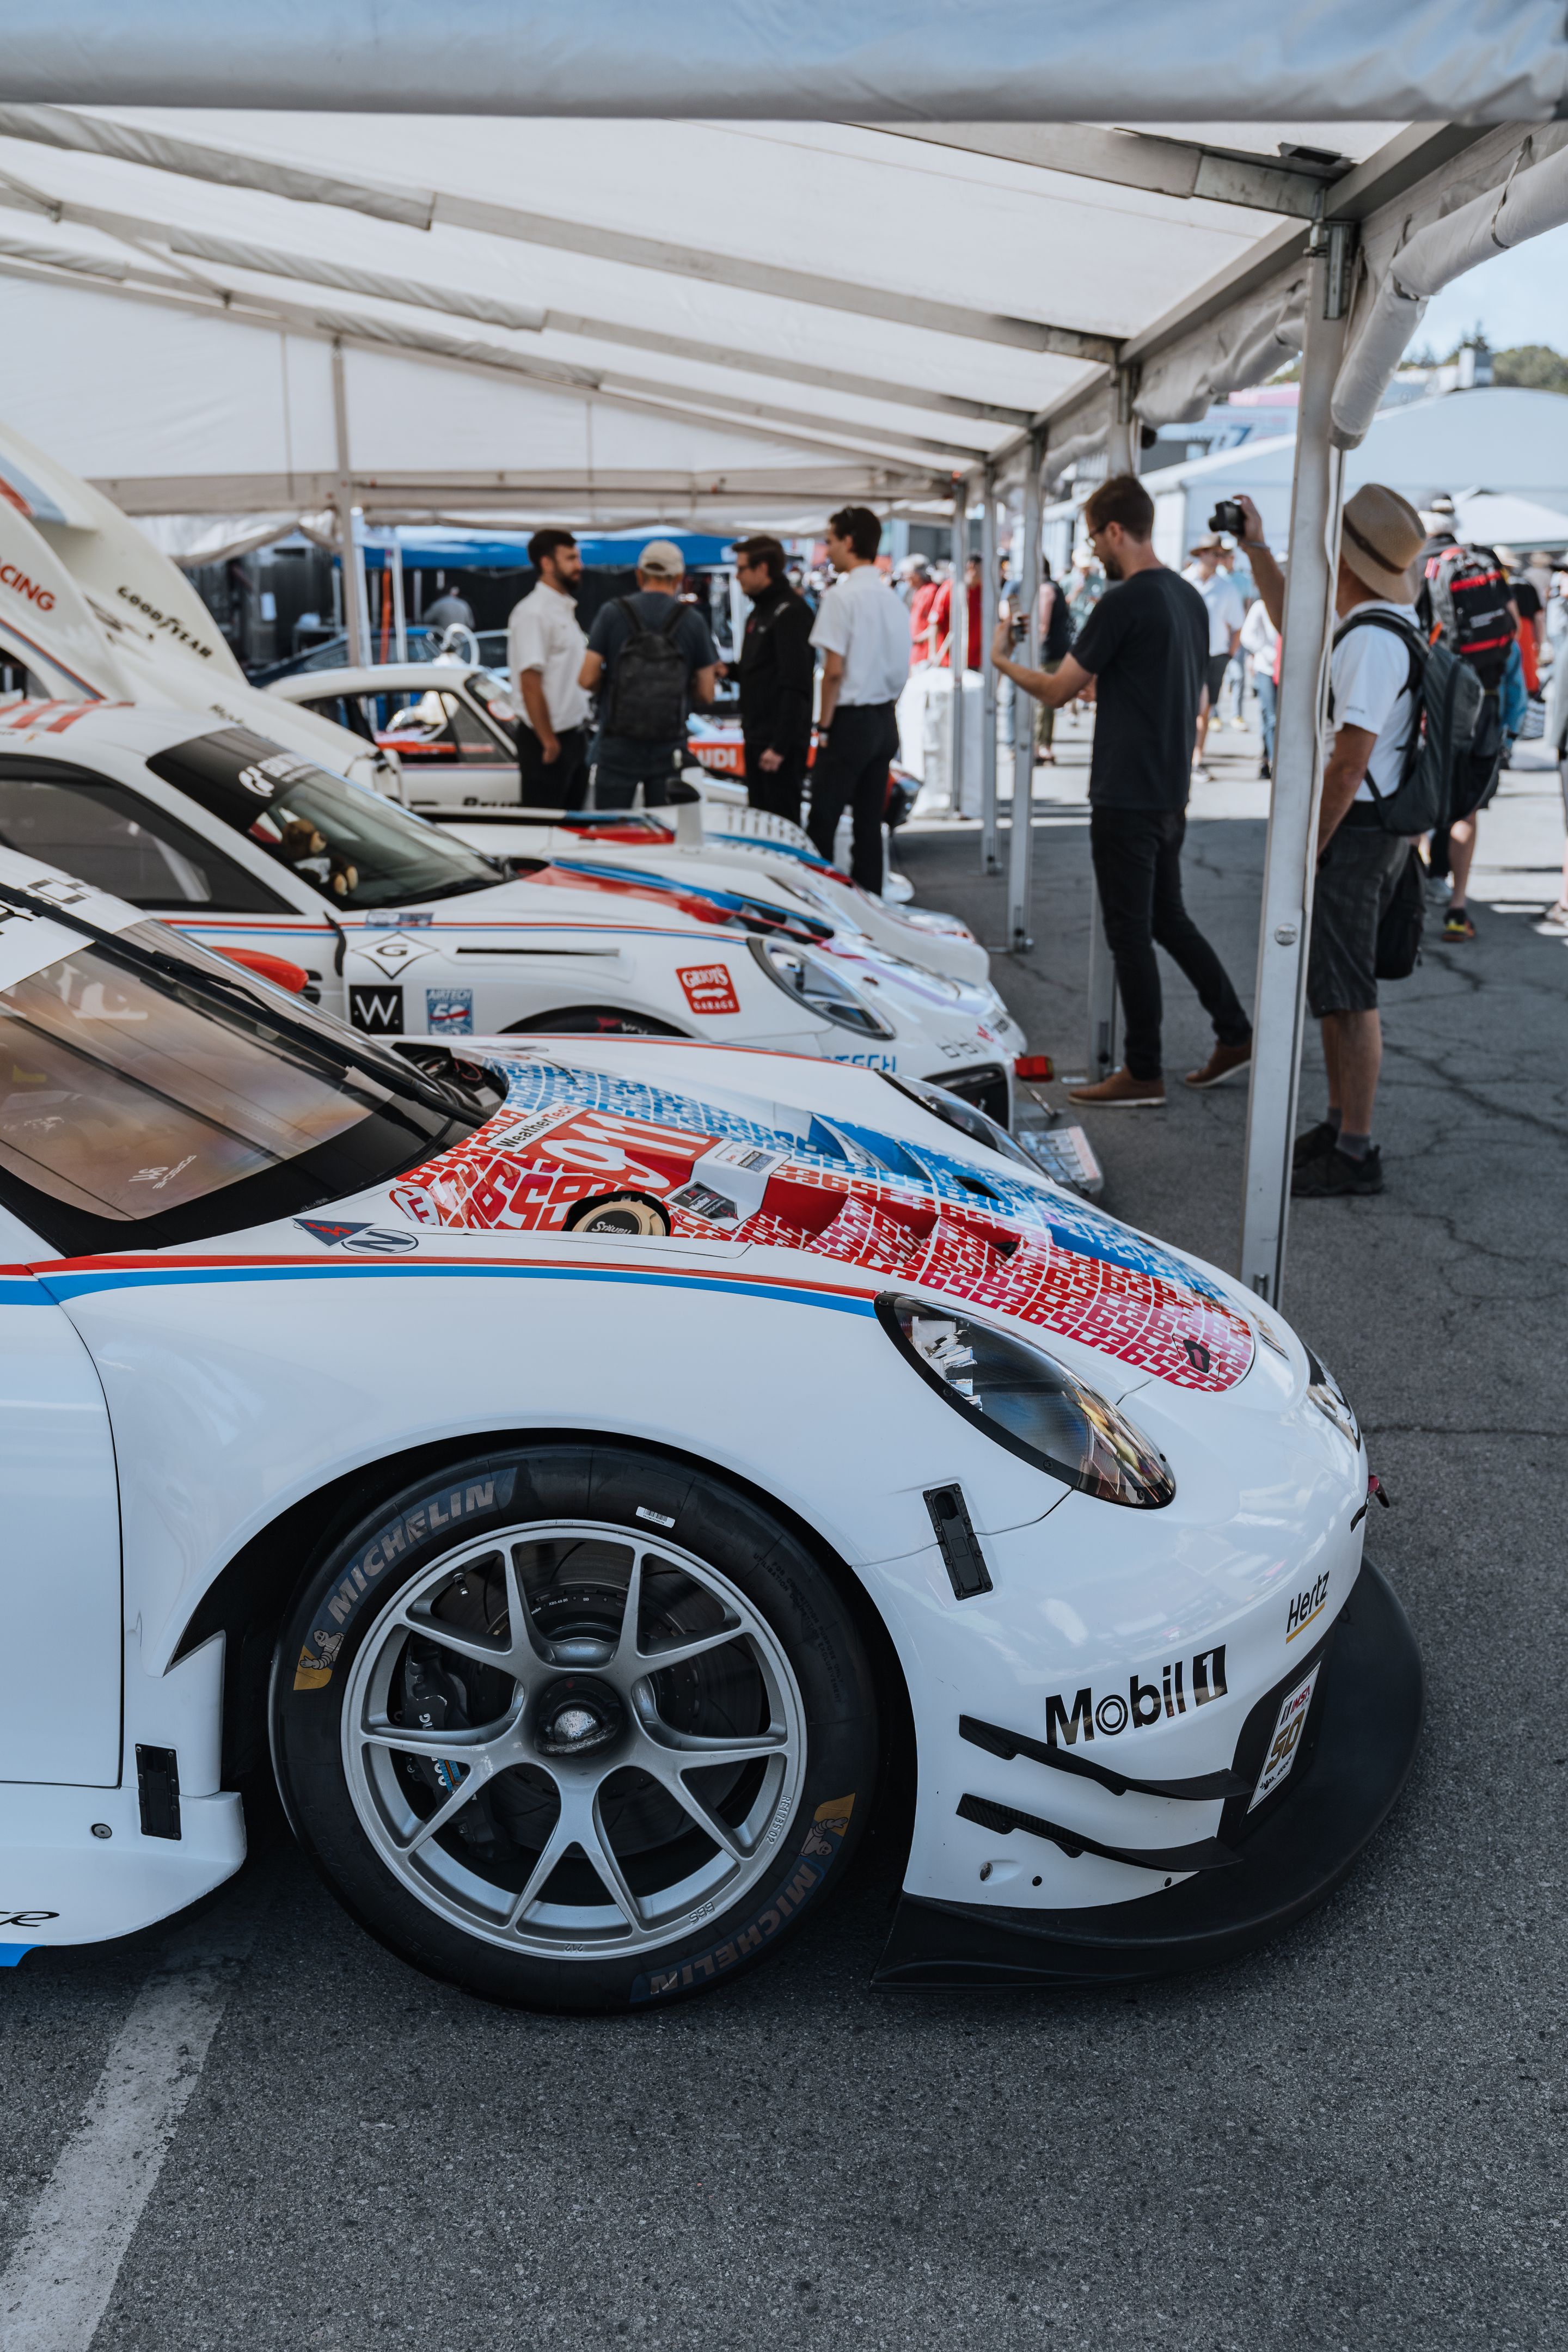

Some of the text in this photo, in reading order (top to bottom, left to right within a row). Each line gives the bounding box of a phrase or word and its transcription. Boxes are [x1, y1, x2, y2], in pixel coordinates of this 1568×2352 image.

[0, 557, 57, 611] CING
[117, 586, 212, 658] GOODYEAR
[693, 748, 737, 769] UDI
[355, 994, 398, 1026] W
[327, 1480, 495, 1625] MICHELIN
[1286, 1570, 1330, 1634] Hertz
[1045, 1661, 1186, 1749] Mobil
[650, 1864, 818, 1995] MICHELIN
